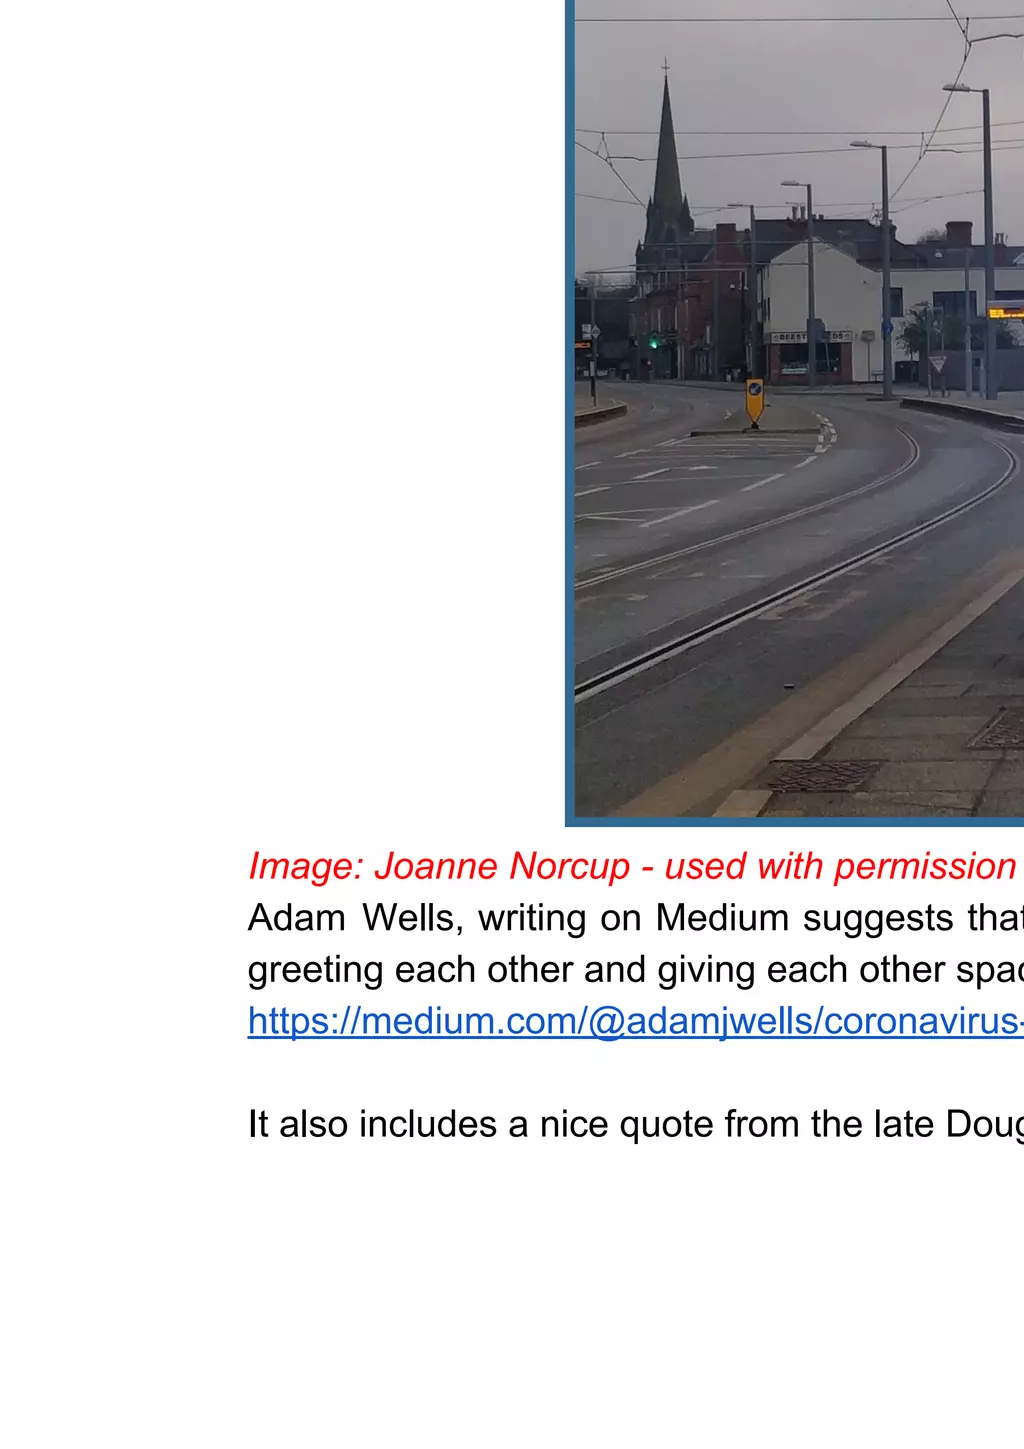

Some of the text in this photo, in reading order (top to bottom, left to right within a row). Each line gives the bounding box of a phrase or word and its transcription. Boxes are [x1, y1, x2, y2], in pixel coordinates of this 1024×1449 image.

[250, 851, 363, 887] Image:
[375, 851, 497, 879] Joanne
[510, 851, 630, 886] Norcup
[666, 851, 747, 879] used
[759, 851, 823, 879] with
[833, 851, 1016, 886] permission
[248, 903, 344, 931] Adam
[362, 903, 462, 936] Wells,
[478, 903, 585, 938] writing
[601, 910, 640, 931] on
[658, 903, 788, 931] Medium
[804, 904, 953, 938] suggests
[249, 955, 382, 990] greeting
[396, 955, 474, 983] each
[488, 955, 574, 982] other
[585, 955, 644, 983] and
[658, 955, 754, 990] giving
[768, 955, 846, 982] each
[860, 954, 946, 982] other
[251, 1109, 268, 1137] It
[280, 1109, 347, 1137] also
[361, 1109, 496, 1137] includes
[509, 1116, 527, 1137] a
[542, 1109, 608, 1137] nice
[621, 1110, 713, 1144] quote
[725, 1109, 798, 1137] from
[811, 1109, 862, 1137] the
[876, 1109, 933, 1137] late
